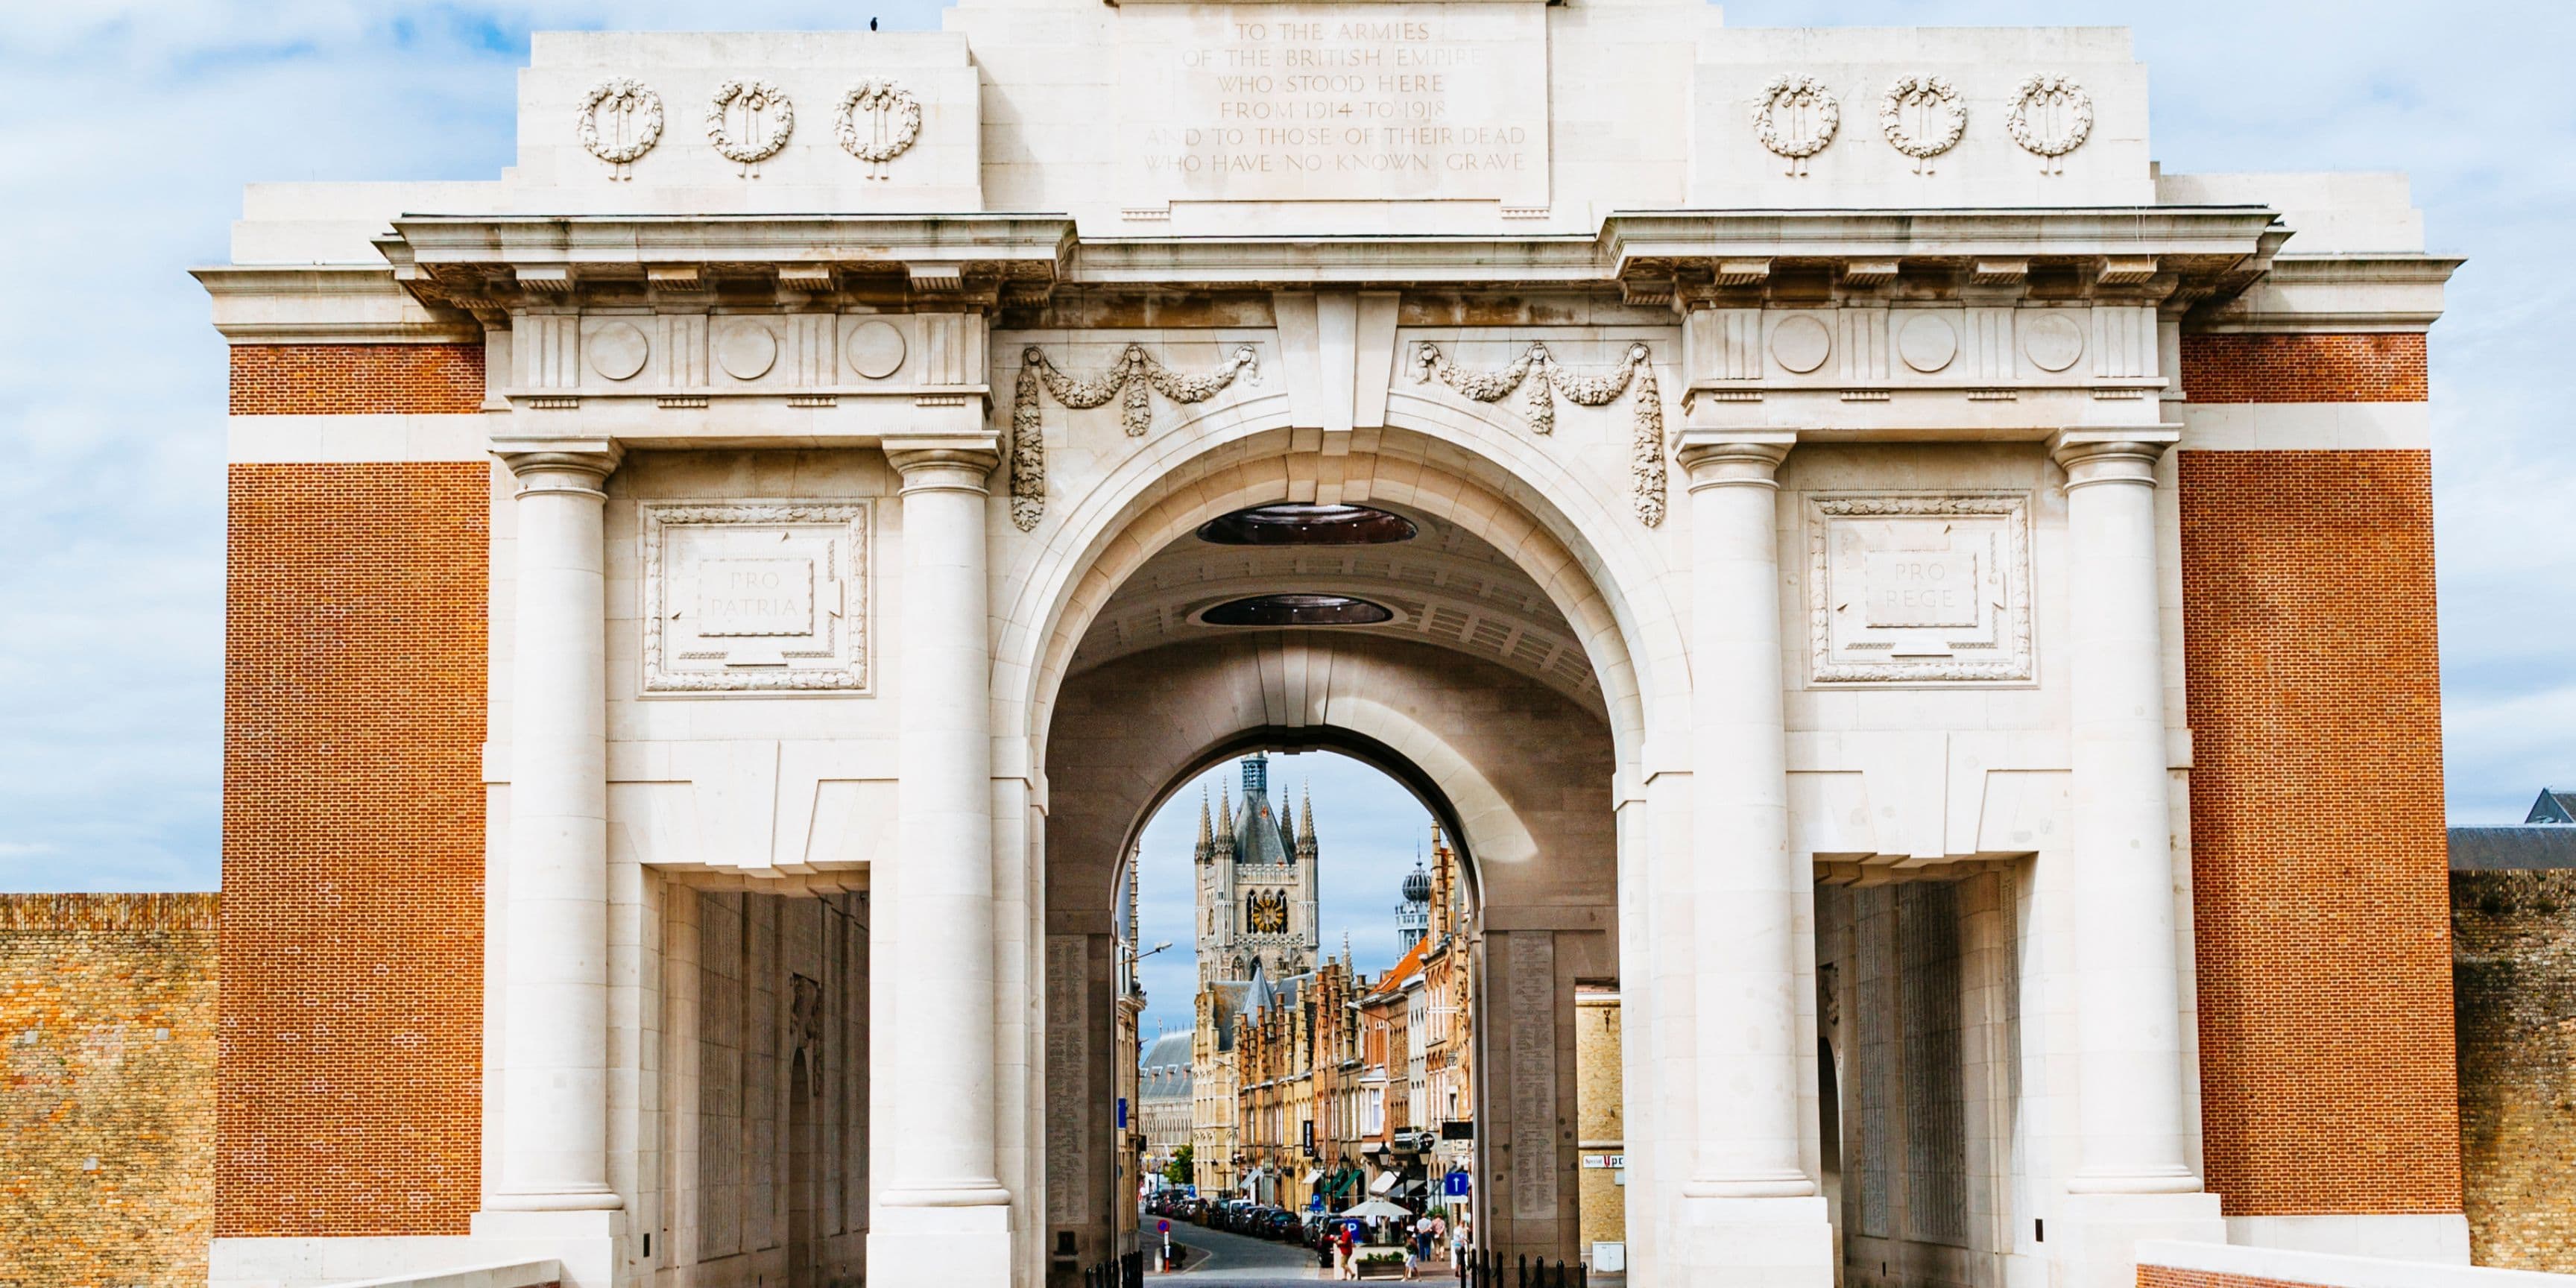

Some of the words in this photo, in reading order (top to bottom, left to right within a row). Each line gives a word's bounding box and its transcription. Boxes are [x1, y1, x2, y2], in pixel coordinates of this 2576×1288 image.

[1235, 22, 1266, 41] TO
[1278, 22, 1323, 41] THE
[1339, 22, 1430, 41] ARMIES
[1182, 49, 1213, 67] OF
[1227, 49, 1270, 67] THE
[1286, 49, 1381, 67] BRITISH
[1397, 49, 1484, 67] EMPIRE
[1218, 75, 1274, 93] WHO
[1285, 75, 1365, 93] STOOD
[1378, 75, 1445, 93] HERE
[1221, 101, 1294, 120] FROM
[1306, 101, 1354, 120] 1914
[1363, 101, 1395, 120] TO
[1404, 101, 1446, 120] 1918
[1145, 127, 1202, 145] AND
[1216, 127, 1244, 145] TO
[1257, 127, 1331, 145] THOSE
[1345, 127, 1374, 145] OF
[1383, 127, 1454, 145] THEIR
[1462, 127, 1527, 145] DEAD
[1144, 154, 1202, 172] WHO
[1212, 154, 1273, 172] HAVE
[1283, 154, 1323, 172] NO
[1336, 154, 1429, 172] KNOWN
[1445, 154, 1527, 172] GRAVE
[730, 572, 780, 590] PRO
[1895, 563, 1945, 581] PRO
[710, 599, 798, 617] PATRIA
[1886, 590, 1956, 608] REGE
[1313, 1195, 1319, 1205] P
[1348, 1222, 1357, 1233] P
